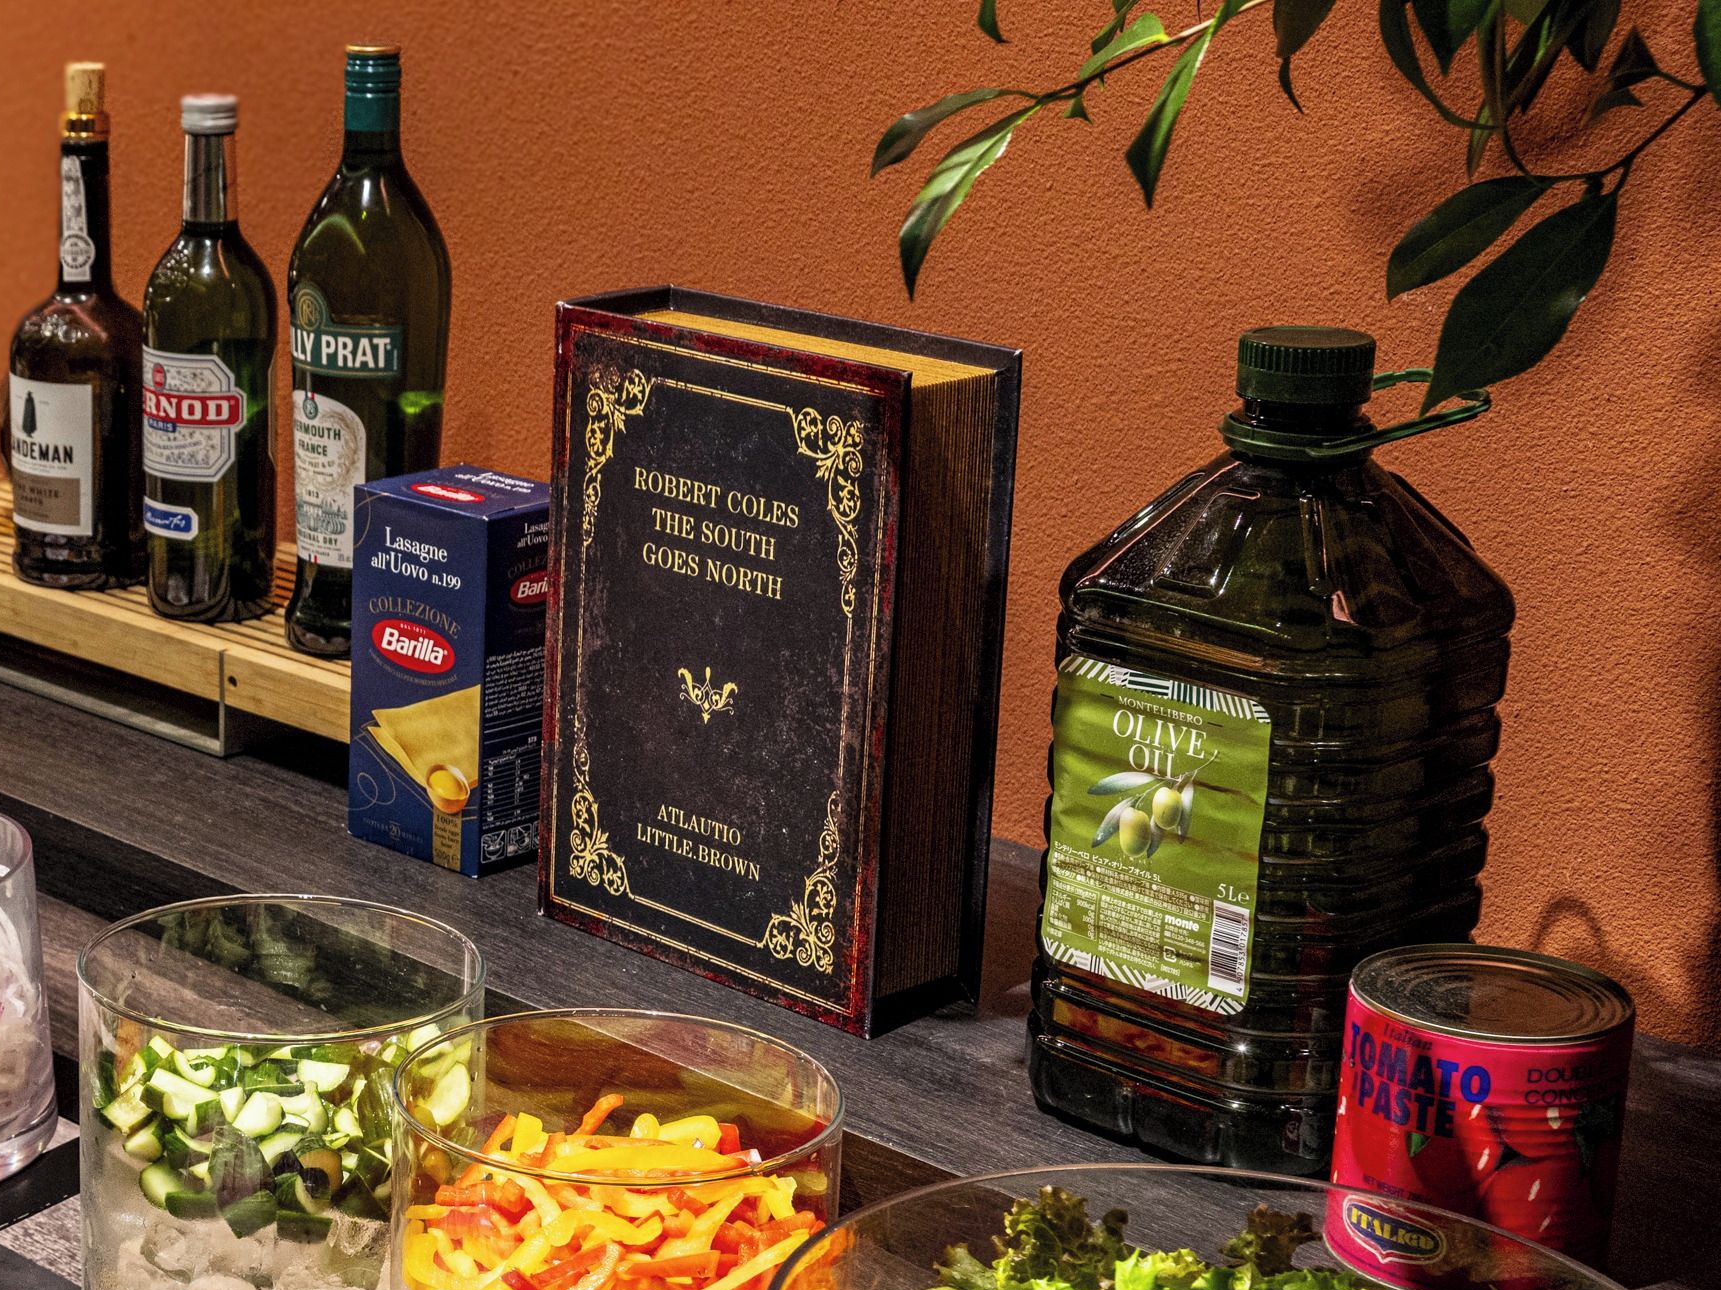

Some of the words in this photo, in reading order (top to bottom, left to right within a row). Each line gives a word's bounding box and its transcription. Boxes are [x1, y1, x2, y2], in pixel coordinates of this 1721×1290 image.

[290, 326, 314, 362] LLY
[321, 334, 391, 369] PRAT
[143, 390, 231, 421] RNOD
[148, 418, 174, 432] PARIS
[298, 438, 328, 457] FRANCE
[633, 466, 721, 509] ROBERT
[727, 490, 800, 528] COLES
[384, 526, 448, 563] Lasagne
[651, 507, 694, 540] THE
[701, 520, 777, 561] SOUTH
[370, 551, 429, 581] all'Uovo
[432, 573, 461, 590] n.199
[642, 542, 699, 577] GOES
[705, 558, 783, 600] NORTH
[368, 595, 461, 639] COLLEZIONE
[380, 626, 445, 666] Barilla
[1118, 695, 1203, 726] MONTELIBERO
[1112, 708, 1208, 760] OLIVE
[1128, 743, 1184, 782] OIL
[657, 803, 741, 846] ATLAUTIO
[636, 822, 761, 882] LITTLE.BROWN
[1164, 914, 1200, 932] monte
[1383, 1022, 1434, 1051] Italian
[1350, 1022, 1491, 1104] TOMATO
[1358, 1072, 1457, 1138] PASTE
